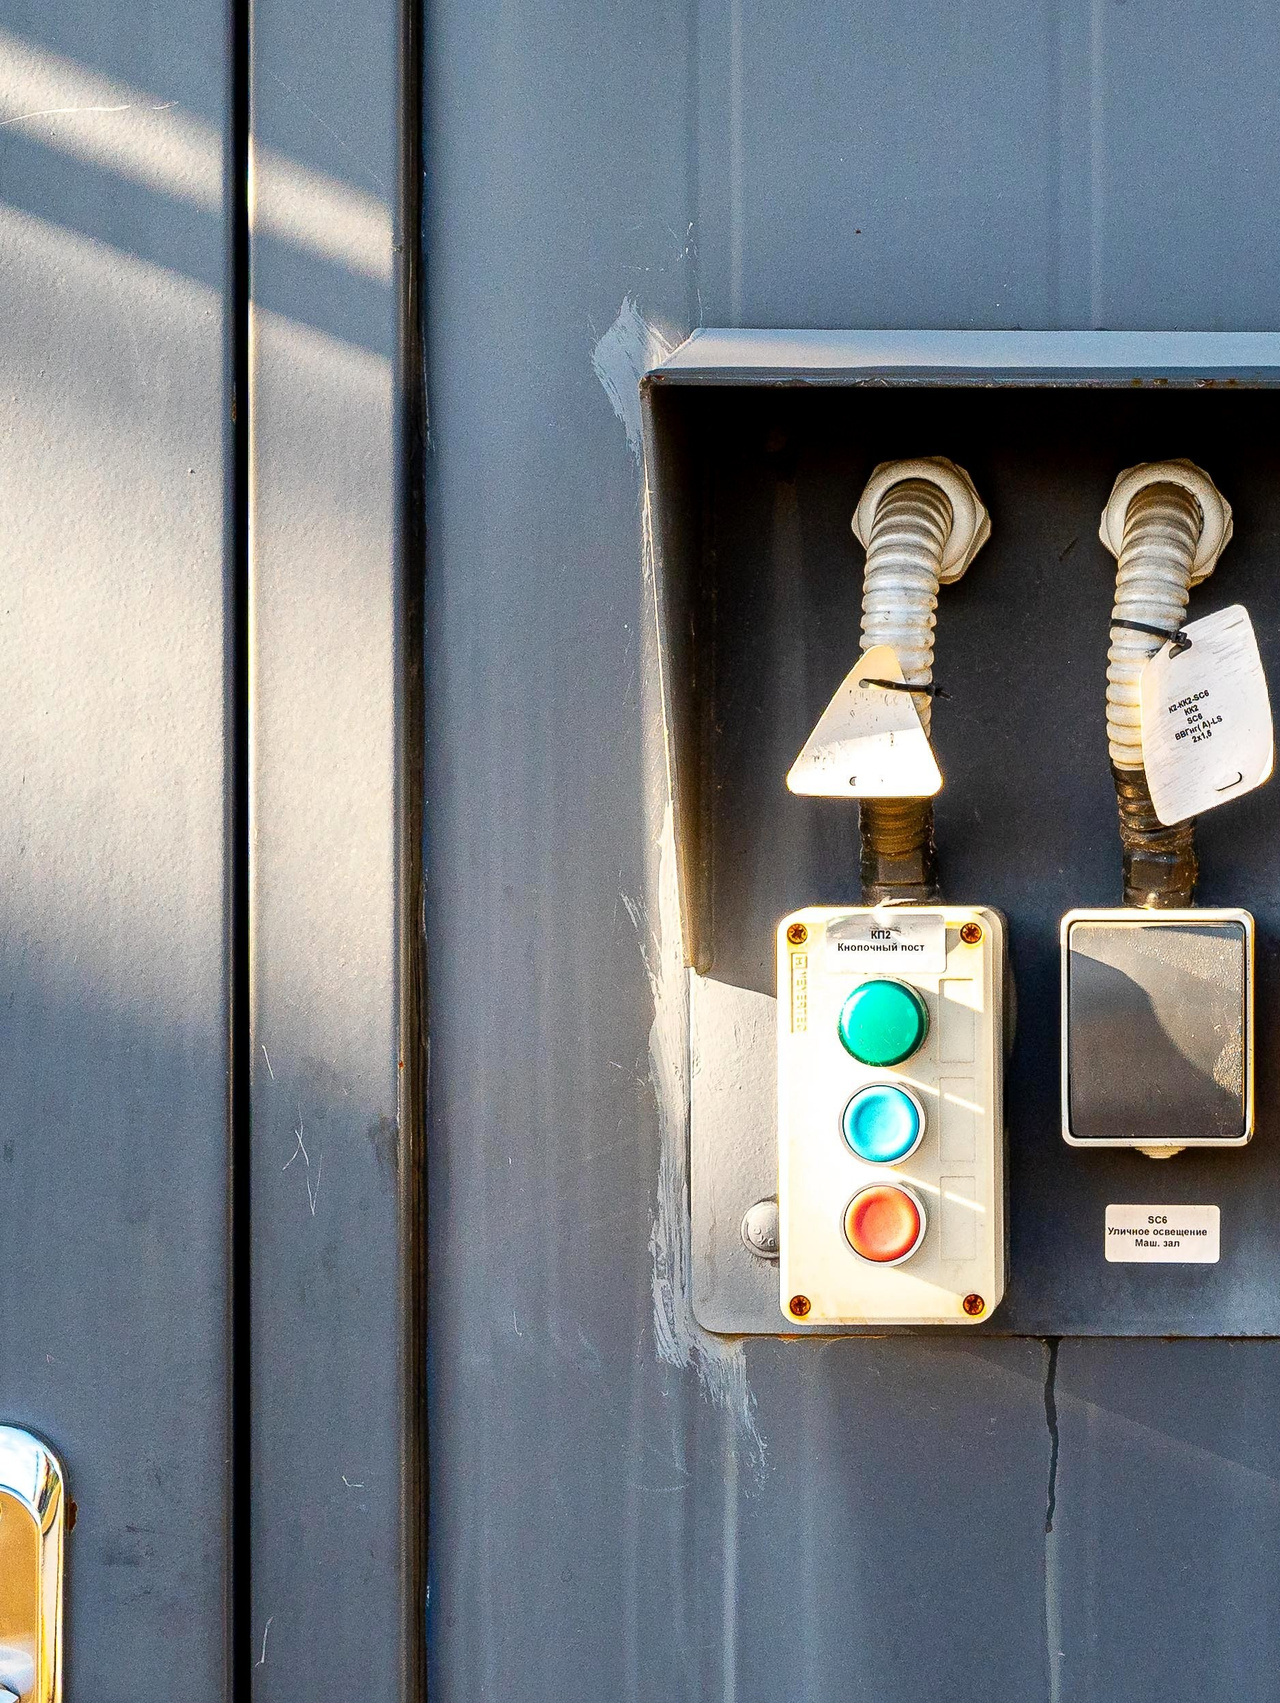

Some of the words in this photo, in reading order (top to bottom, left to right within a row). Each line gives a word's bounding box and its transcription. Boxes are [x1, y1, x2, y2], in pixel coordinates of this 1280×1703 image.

[1187, 713, 1203, 724] SC6
[870, 930, 891, 940] КП2
[837, 942, 898, 952] Кнопочный
[901, 944, 925, 952] пост
[1147, 1215, 1168, 1224] SC6
[1107, 1227, 1150, 1236] Уличное
[1152, 1228, 1208, 1237] освещение
[1135, 1239, 1160, 1248] Маш.
[1163, 1240, 1180, 1248] зал
